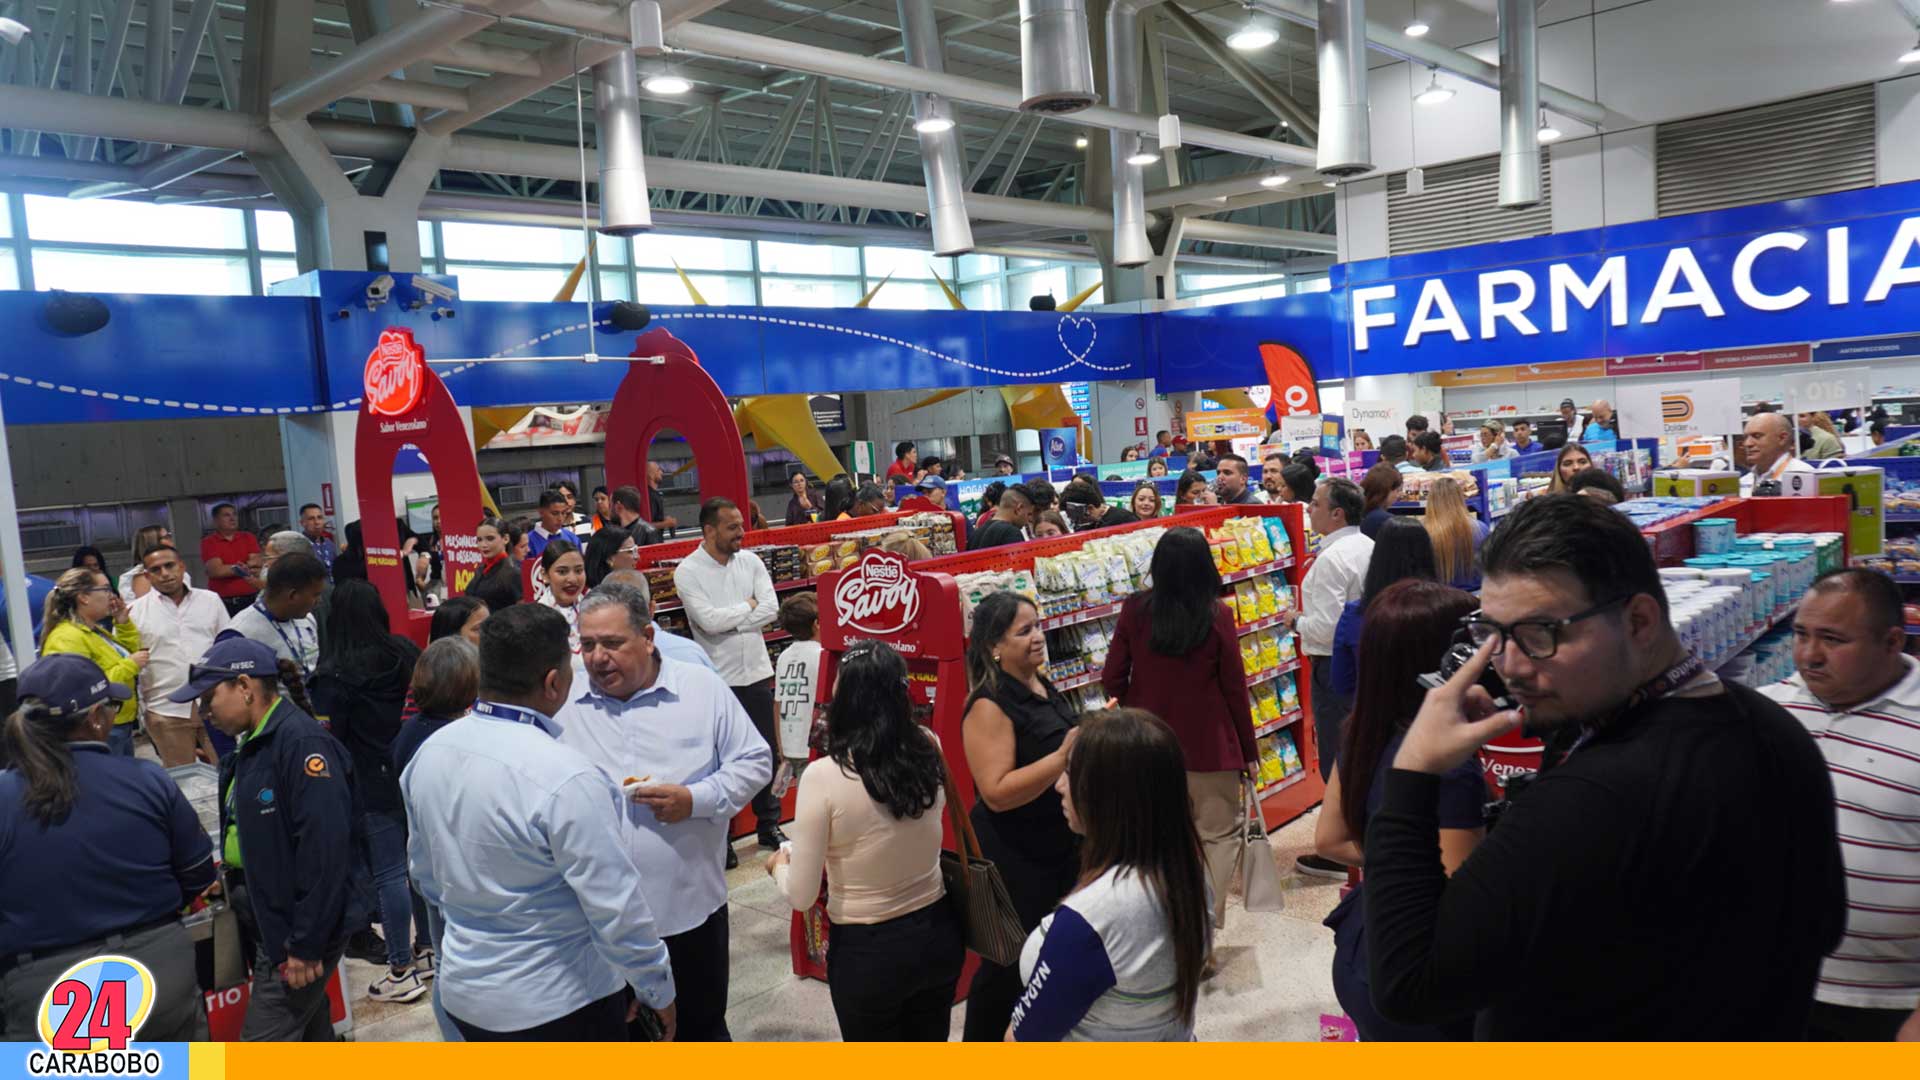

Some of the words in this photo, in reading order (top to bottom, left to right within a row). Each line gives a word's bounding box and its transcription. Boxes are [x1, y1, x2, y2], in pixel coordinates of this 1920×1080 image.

[1353, 215, 1920, 352] FARMACIA
[445, 534, 479, 549] PERSONALIZ
[837, 578, 918, 627] Savoy
[230, 660, 255, 671] AVSEC
[1020, 960, 1051, 1009] NADA
